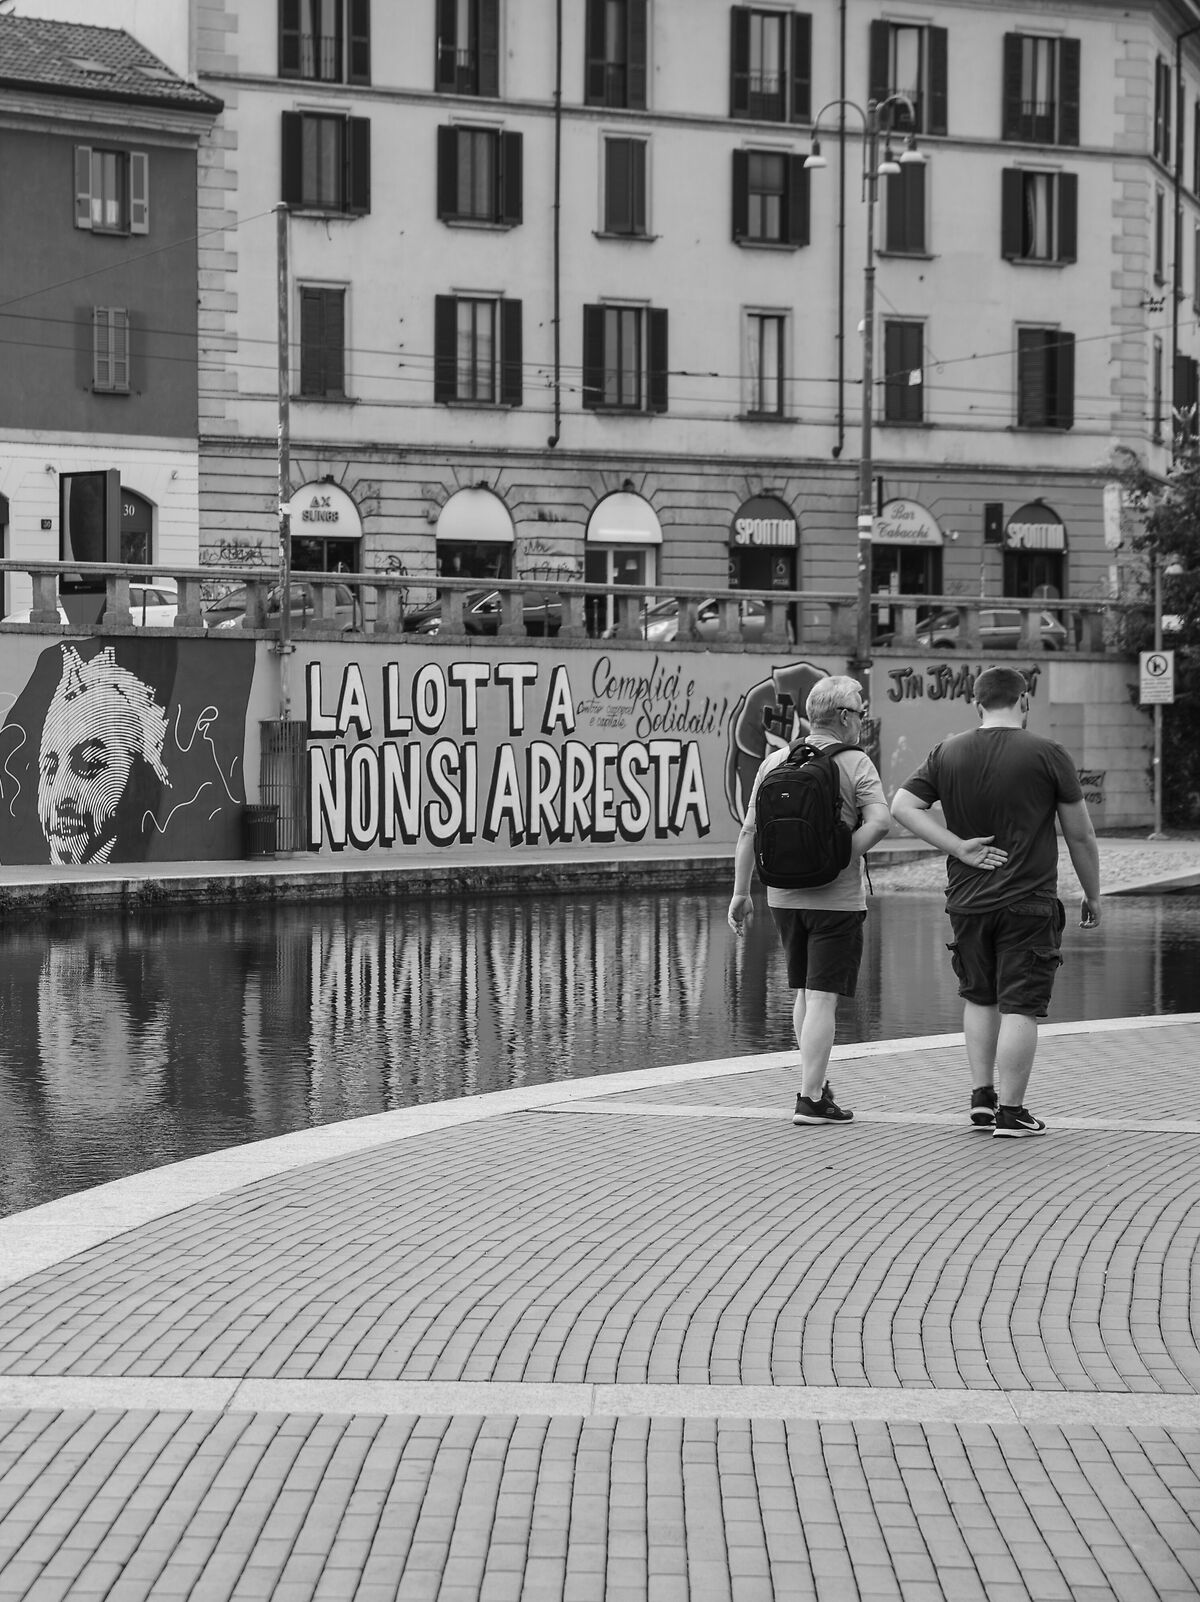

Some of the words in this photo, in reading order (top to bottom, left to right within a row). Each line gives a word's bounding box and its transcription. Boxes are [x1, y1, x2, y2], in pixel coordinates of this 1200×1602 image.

[123, 504, 135, 516] 30
[877, 521, 930, 538] Tabacchi
[891, 504, 915, 520] Bar
[306, 661, 373, 740] LA
[382, 661, 576, 737] LOTTA
[592, 654, 682, 714] Complici
[686, 679, 695, 697] e
[636, 698, 728, 739] Solidali!
[482, 739, 710, 847] ARRESTA
